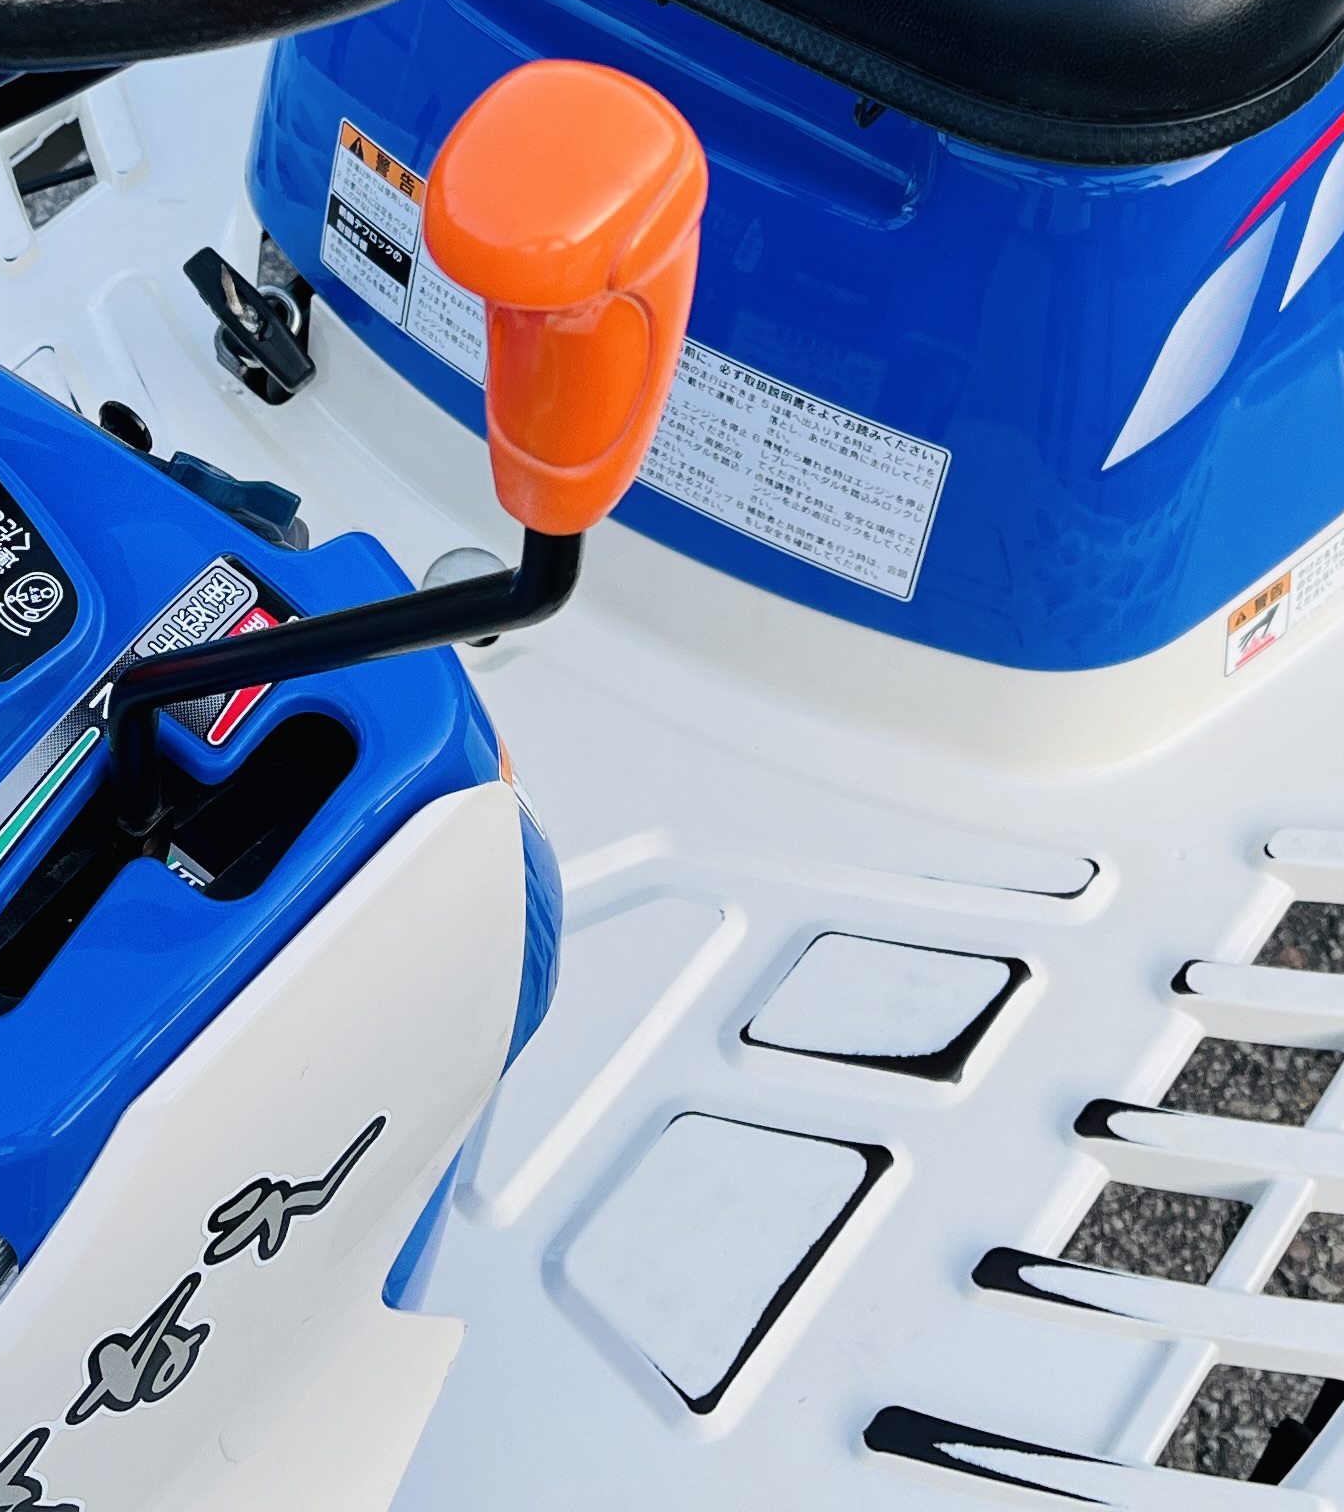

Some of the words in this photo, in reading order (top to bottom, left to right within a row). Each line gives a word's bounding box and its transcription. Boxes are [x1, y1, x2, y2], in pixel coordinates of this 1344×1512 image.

[374, 149, 417, 200] 警告
[677, 342, 942, 466] 前に、必ず取扱説明書をよくお読みください。
[641, 453, 733, 506] の十分あるスリップ
[646, 443, 720, 488] 降ろしする時は、
